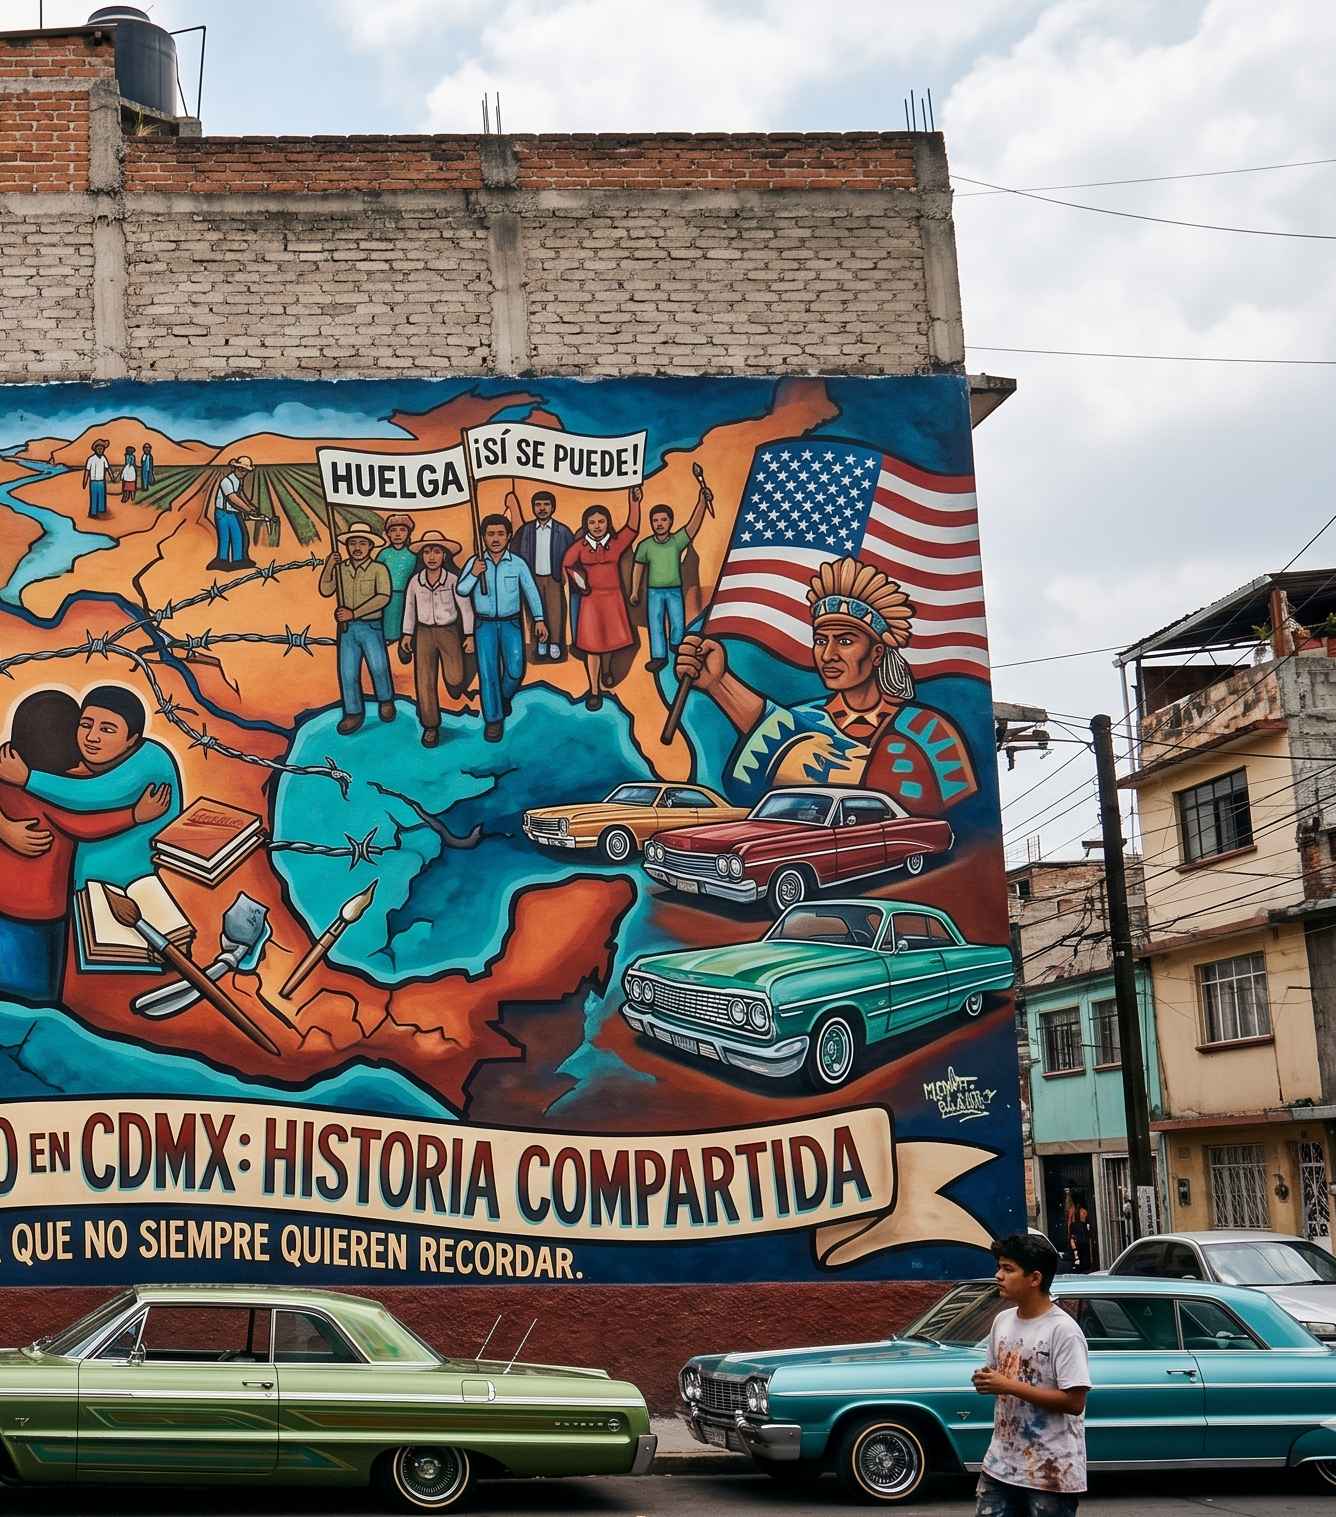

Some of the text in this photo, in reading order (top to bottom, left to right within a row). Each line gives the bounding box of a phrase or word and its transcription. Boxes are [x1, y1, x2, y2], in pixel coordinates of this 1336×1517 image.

[331, 461, 464, 499] HUELGA
[473, 428, 639, 478] ¡SÍ SE PUEDE!
[28, 1131, 71, 1175] EN
[80, 1111, 251, 1194] CDMX:
[262, 1114, 501, 1221] HISTORIA
[516, 1125, 874, 1229] COMPARTIDA
[10, 1219, 74, 1267] QUE
[84, 1219, 128, 1260] NO
[138, 1219, 270, 1262] SIEMPRE
[280, 1224, 408, 1271] QUIEREN
[418, 1236, 584, 1281] RECORDAR.
